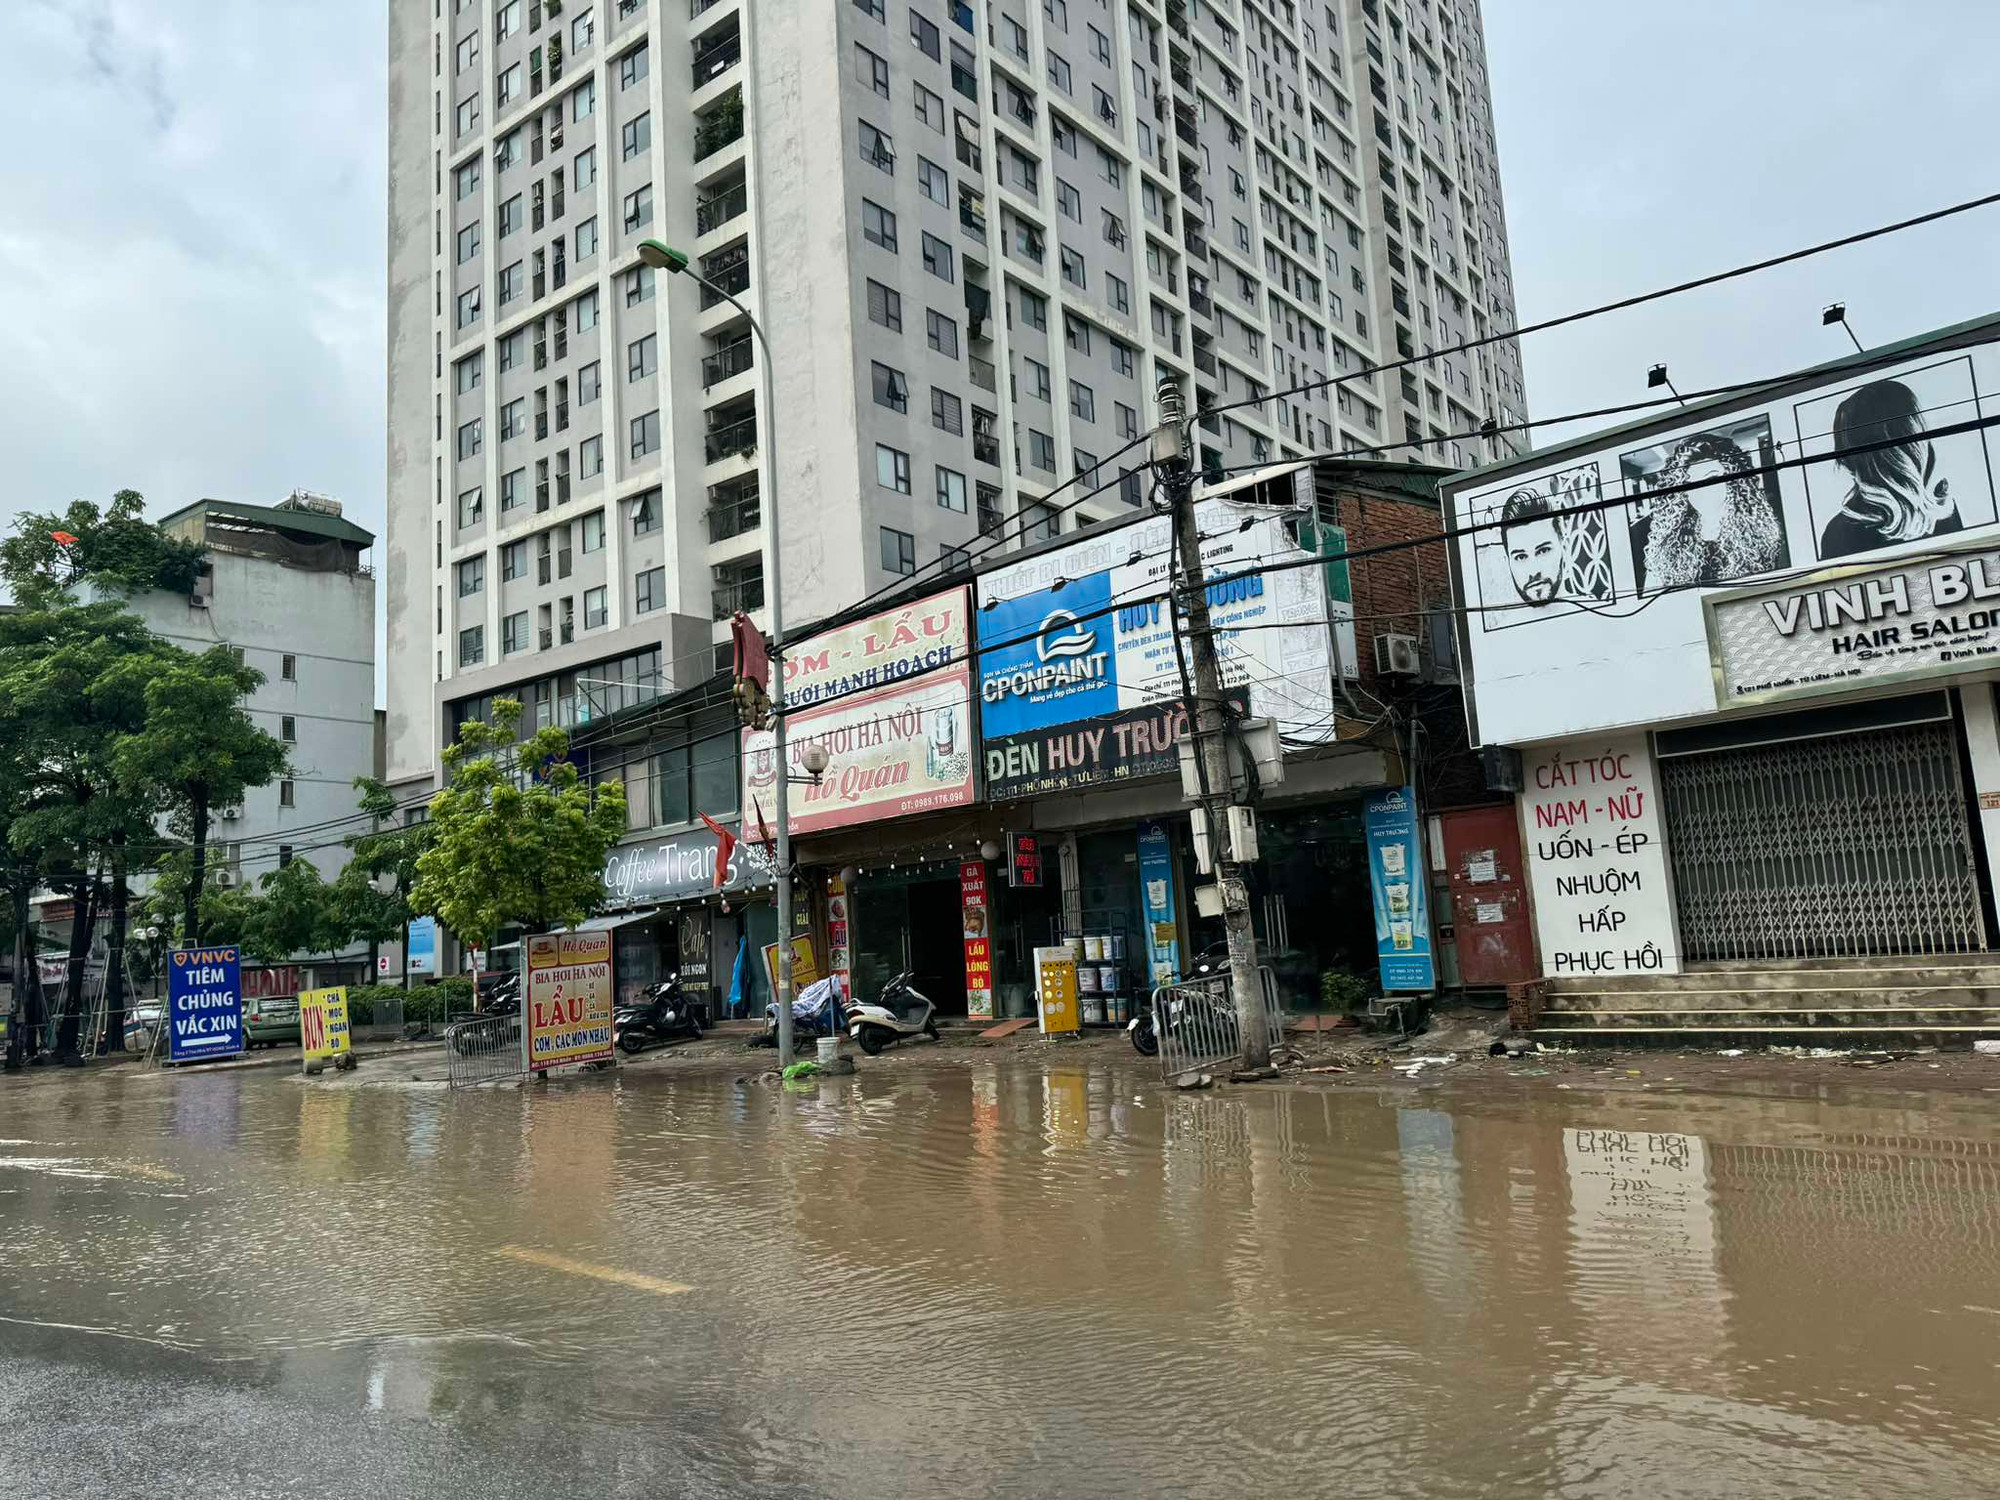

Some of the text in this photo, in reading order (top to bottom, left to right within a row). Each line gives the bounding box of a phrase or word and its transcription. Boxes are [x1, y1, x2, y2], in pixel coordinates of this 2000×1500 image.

[1207, 544, 1234, 559] LIGHTING
[1762, 572, 1912, 638] VINH
[863, 611, 953, 657] LẨU
[1832, 626, 1901, 655] HAIR
[1952, 646, 1974, 658] Vinh
[982, 652, 1109, 703] CPONPAINT
[857, 712, 883, 749] HÀ
[888, 703, 923, 742] NỘI
[987, 738, 1040, 782] ĐÈN
[1047, 728, 1105, 771] HUY
[1535, 748, 1633, 790] CẮT TÓC
[840, 755, 911, 803] Quán
[1114, 765, 1129, 777] HN
[1535, 798, 1588, 829] NAM
[1610, 785, 1645, 822] NỮ
[1538, 828, 1593, 861] UỐN
[1616, 826, 1650, 855] ÉP
[1556, 867, 1641, 897] NHUỘM
[1578, 905, 1627, 933] HẤP
[190, 950, 235, 965] VNVC
[1554, 940, 1664, 975] PHỤC HỒI
[186, 966, 225, 985] TIÊM
[535, 972, 550, 985] BIA
[573, 966, 586, 981] HÀ
[588, 963, 606, 978] NỘI
[178, 989, 234, 1011] CHỦNG
[534, 984, 585, 1028] LẨU
[176, 1014, 237, 1036] VẮC XIN
[330, 1021, 348, 1034] NGAN
[571, 1027, 587, 1047] MÔN
